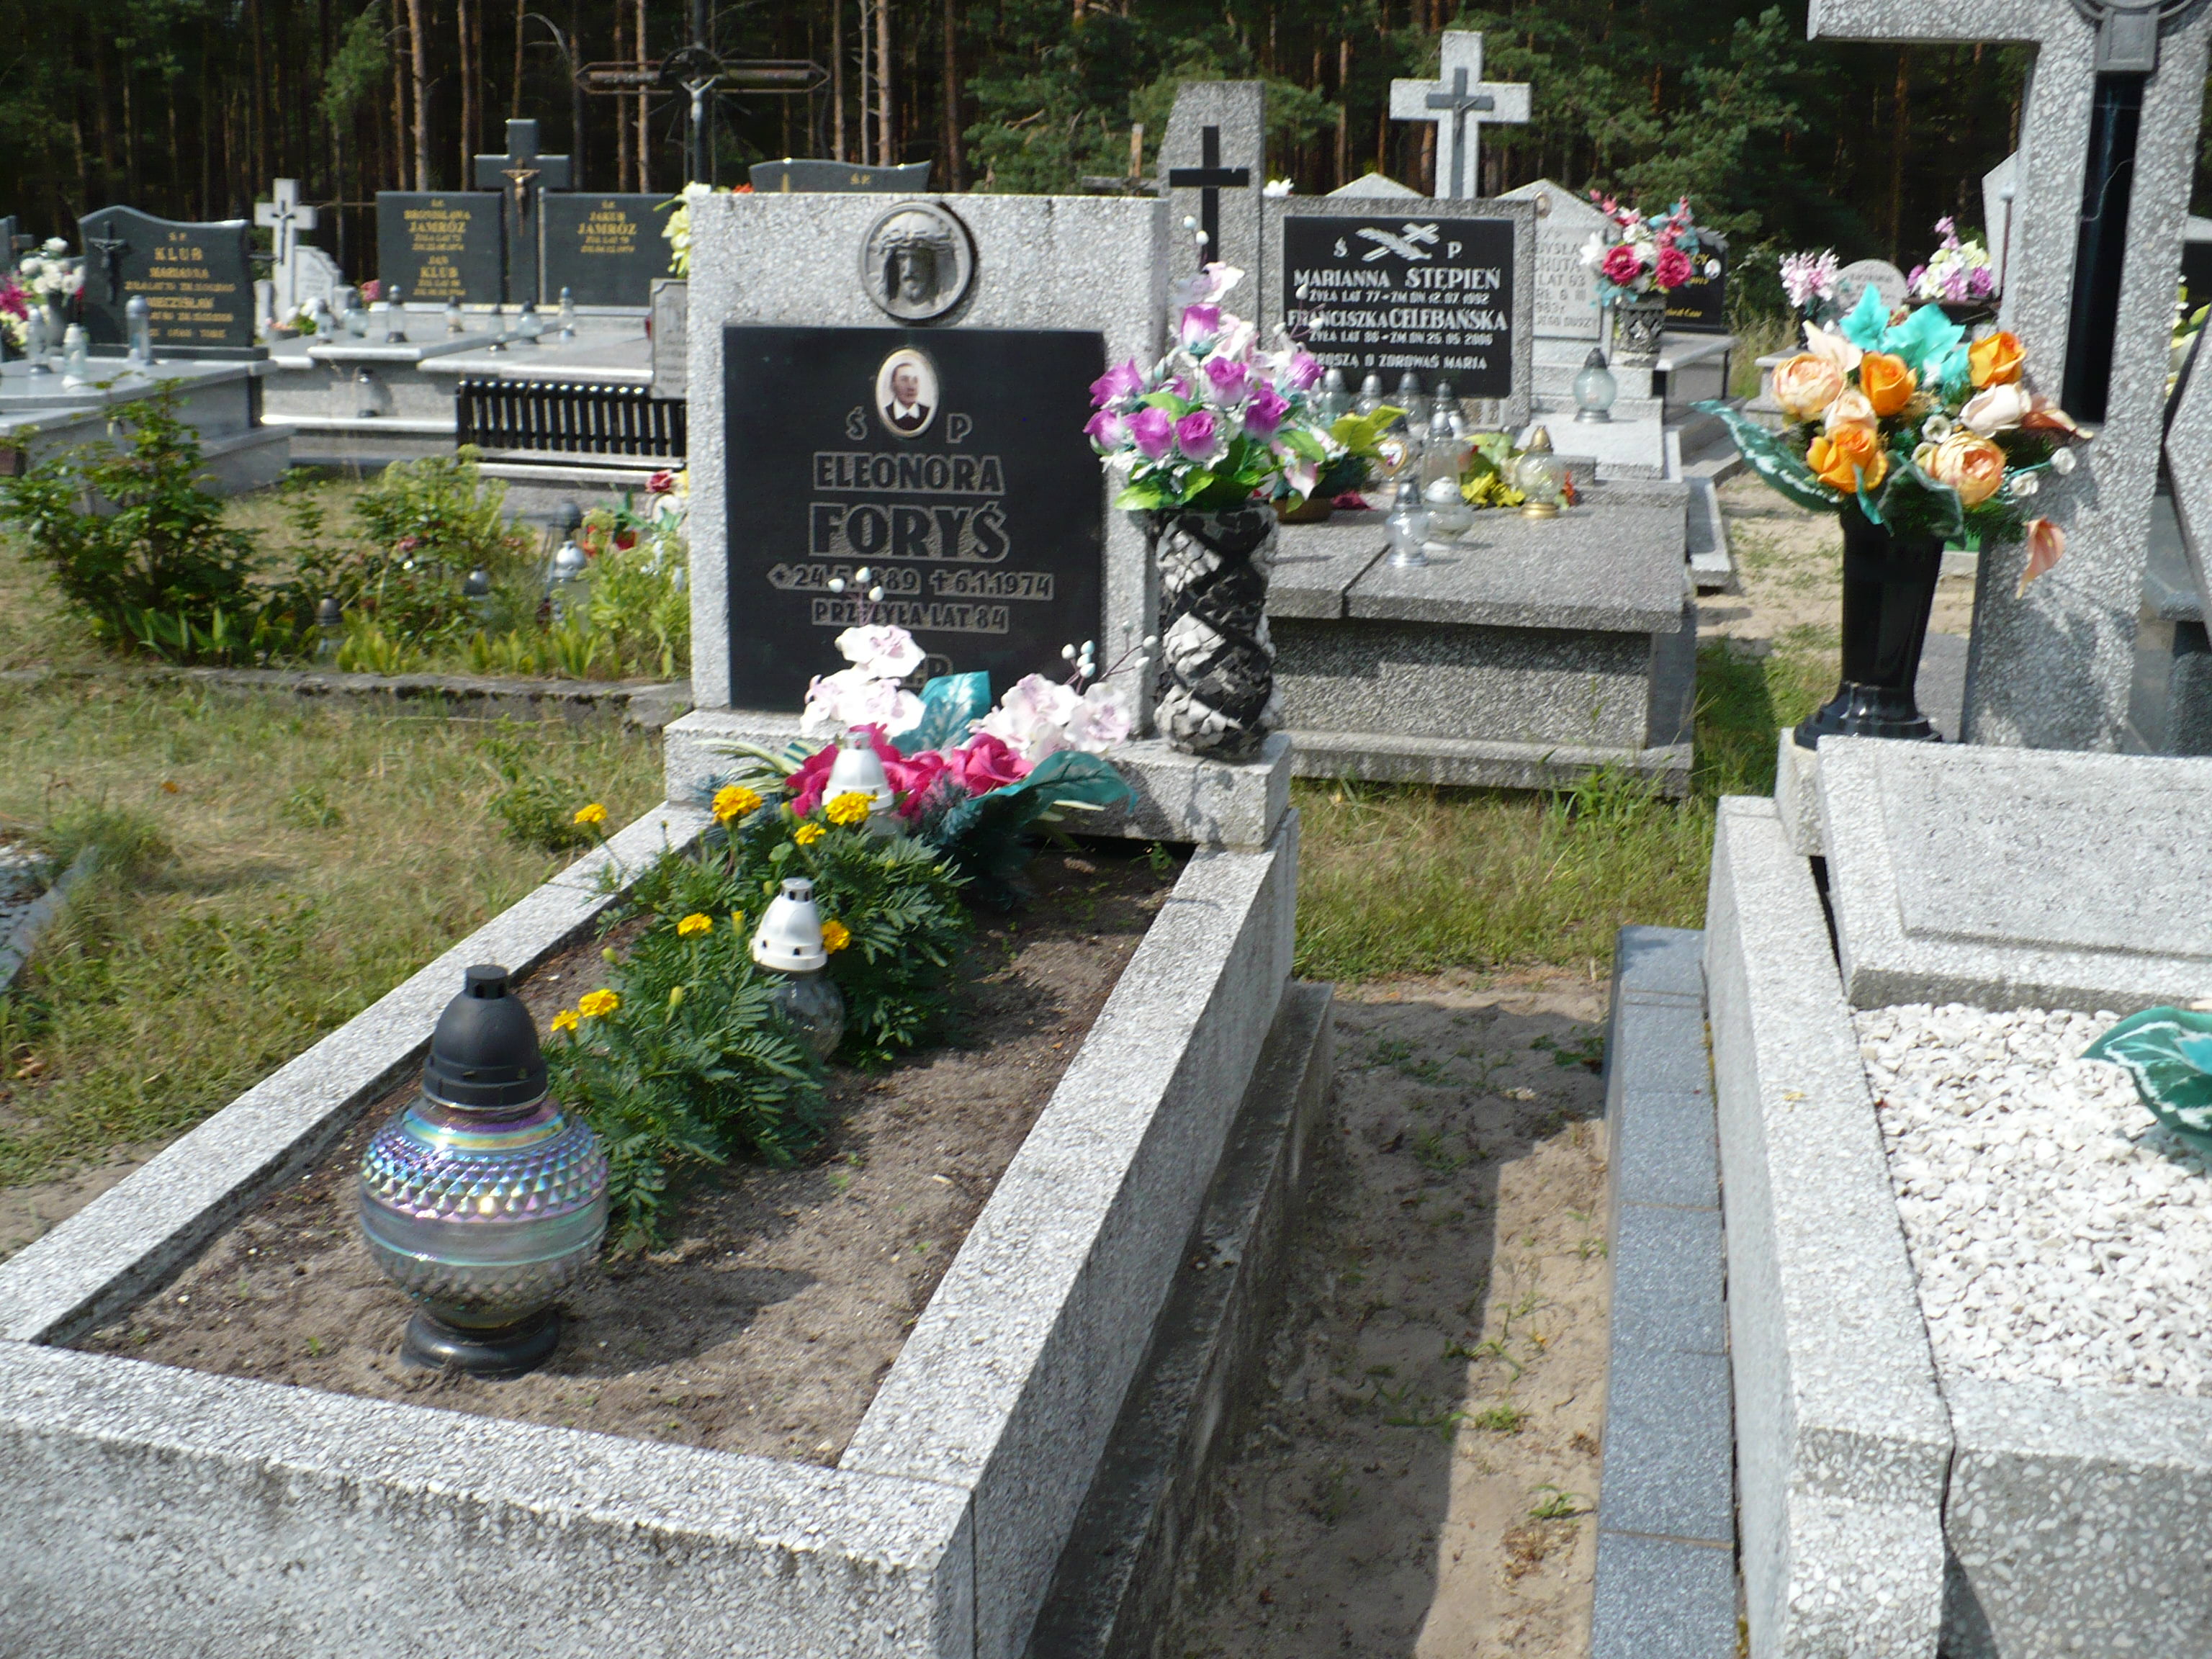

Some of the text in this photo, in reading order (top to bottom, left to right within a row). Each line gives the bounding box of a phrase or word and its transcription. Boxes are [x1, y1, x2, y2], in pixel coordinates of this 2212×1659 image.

[577, 222, 637, 235] JAMRÓZ
[1294, 266, 1501, 291] MARIANNA STĘPIEŃ
[1341, 289, 1362, 302] LAT
[1287, 309, 1389, 328] FRANCISZKA
[1341, 330, 1361, 343] LAT
[1364, 353, 1375, 367] O
[1443, 355, 1488, 370] MARIA
[814, 451, 1006, 495] ELEONORA
[809, 501, 1010, 563] FORYŚ
[792, 565, 922, 595] 245.889
[930, 603, 974, 630] LAT
[974, 606, 1010, 634] 84
